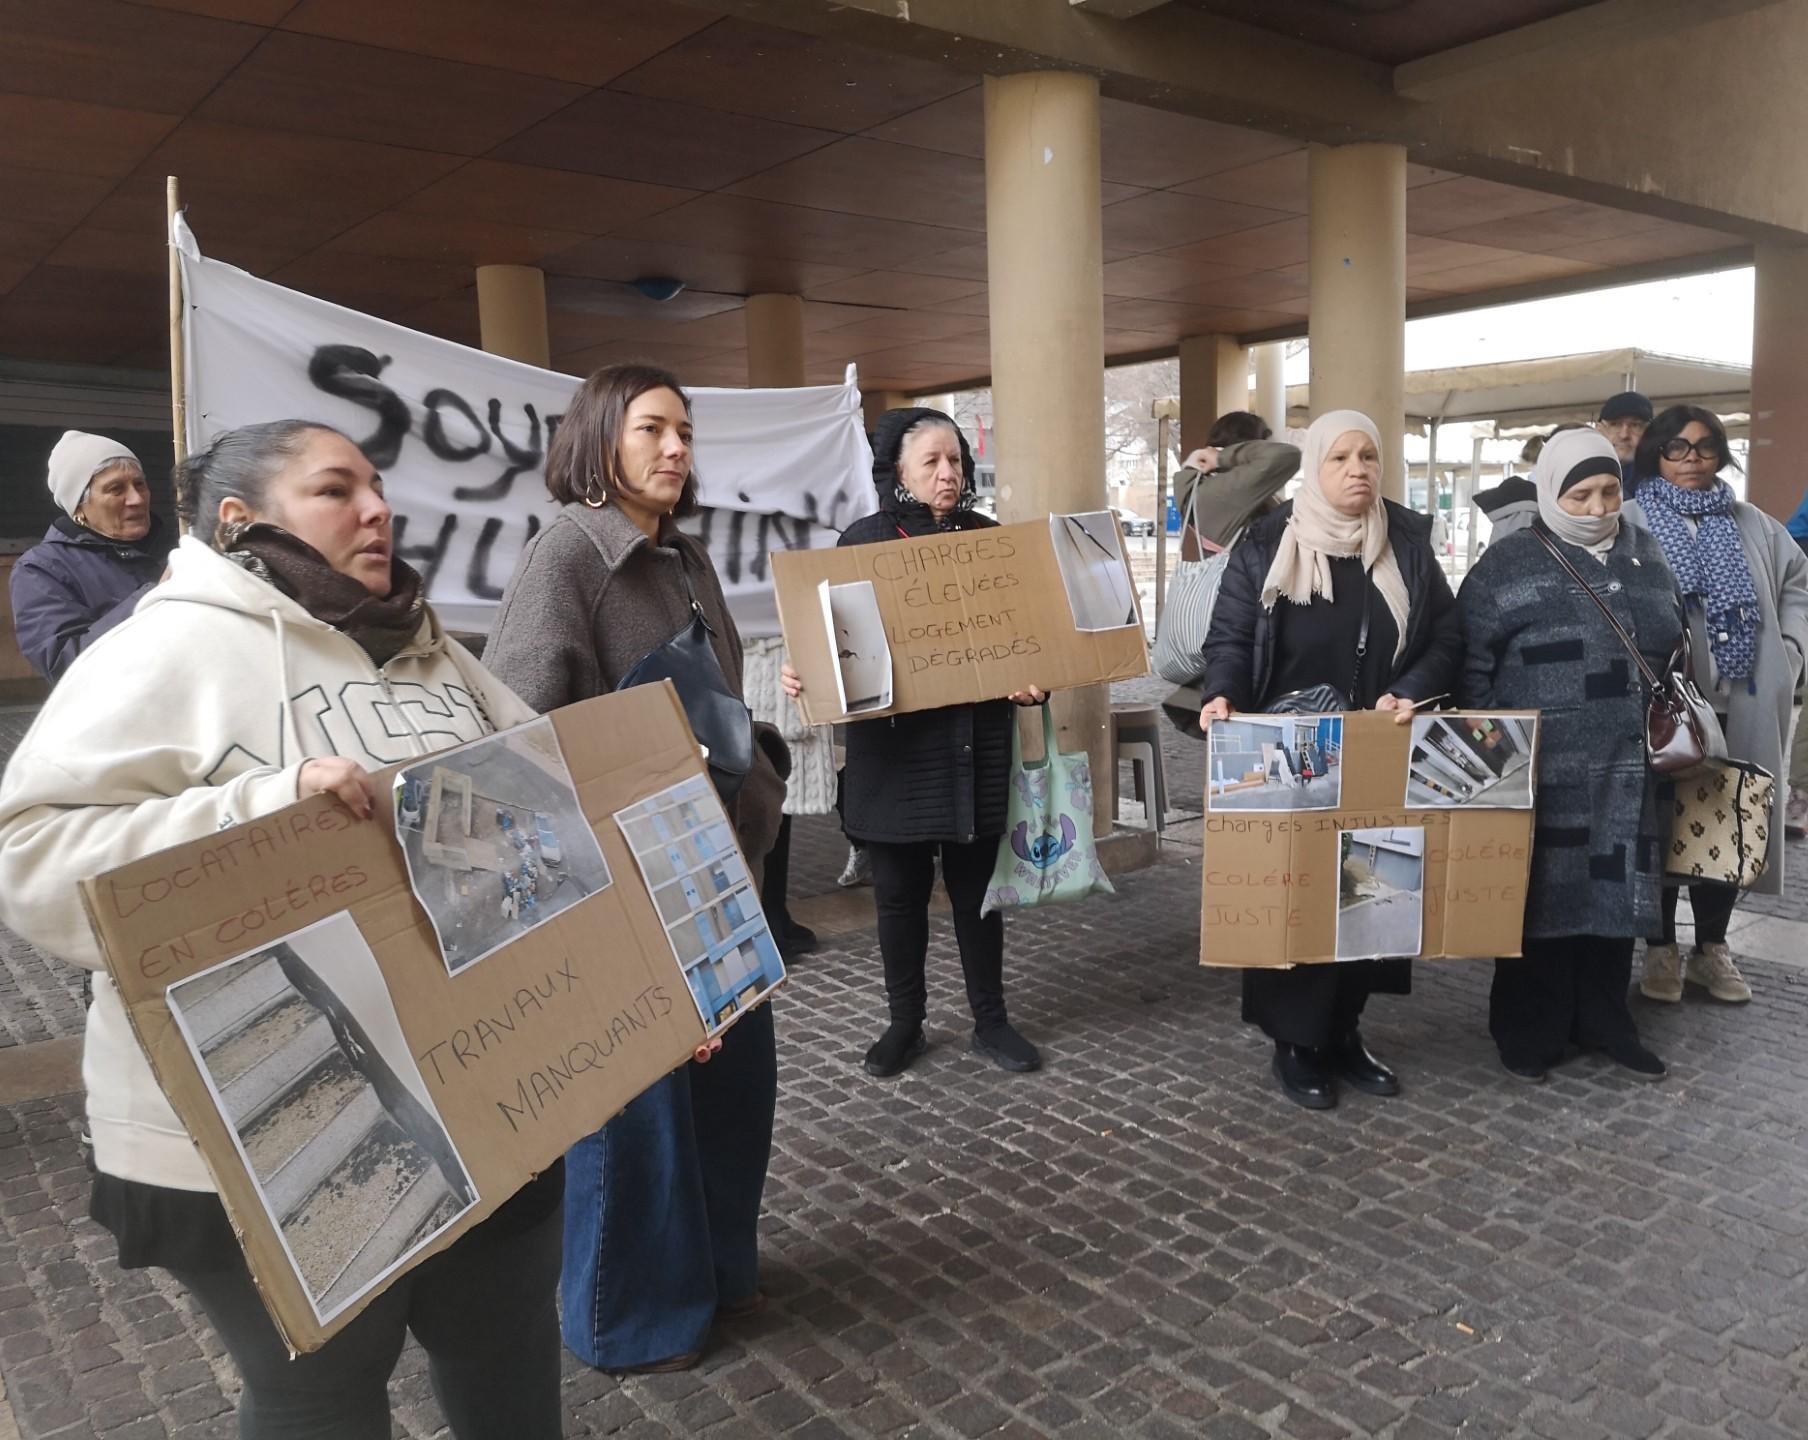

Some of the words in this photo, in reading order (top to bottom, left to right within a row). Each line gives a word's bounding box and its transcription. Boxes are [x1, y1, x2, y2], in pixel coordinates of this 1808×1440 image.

[872, 535, 1017, 581] CHARGES
[904, 573, 1020, 609] ÉLEVÉES
[892, 608, 1017, 645] LOGEMENT
[1314, 811, 1451, 832] INJUSTES
[109, 802, 353, 919] LOCATAIRES
[1207, 903, 1303, 928] JUSTE
[1424, 883, 1518, 914] JUSTE
[139, 933, 195, 979] EN
[215, 865, 369, 944] COLÉRES
[419, 958, 580, 1085] TRAVAUX
[496, 985, 673, 1132] MANQUANTS
